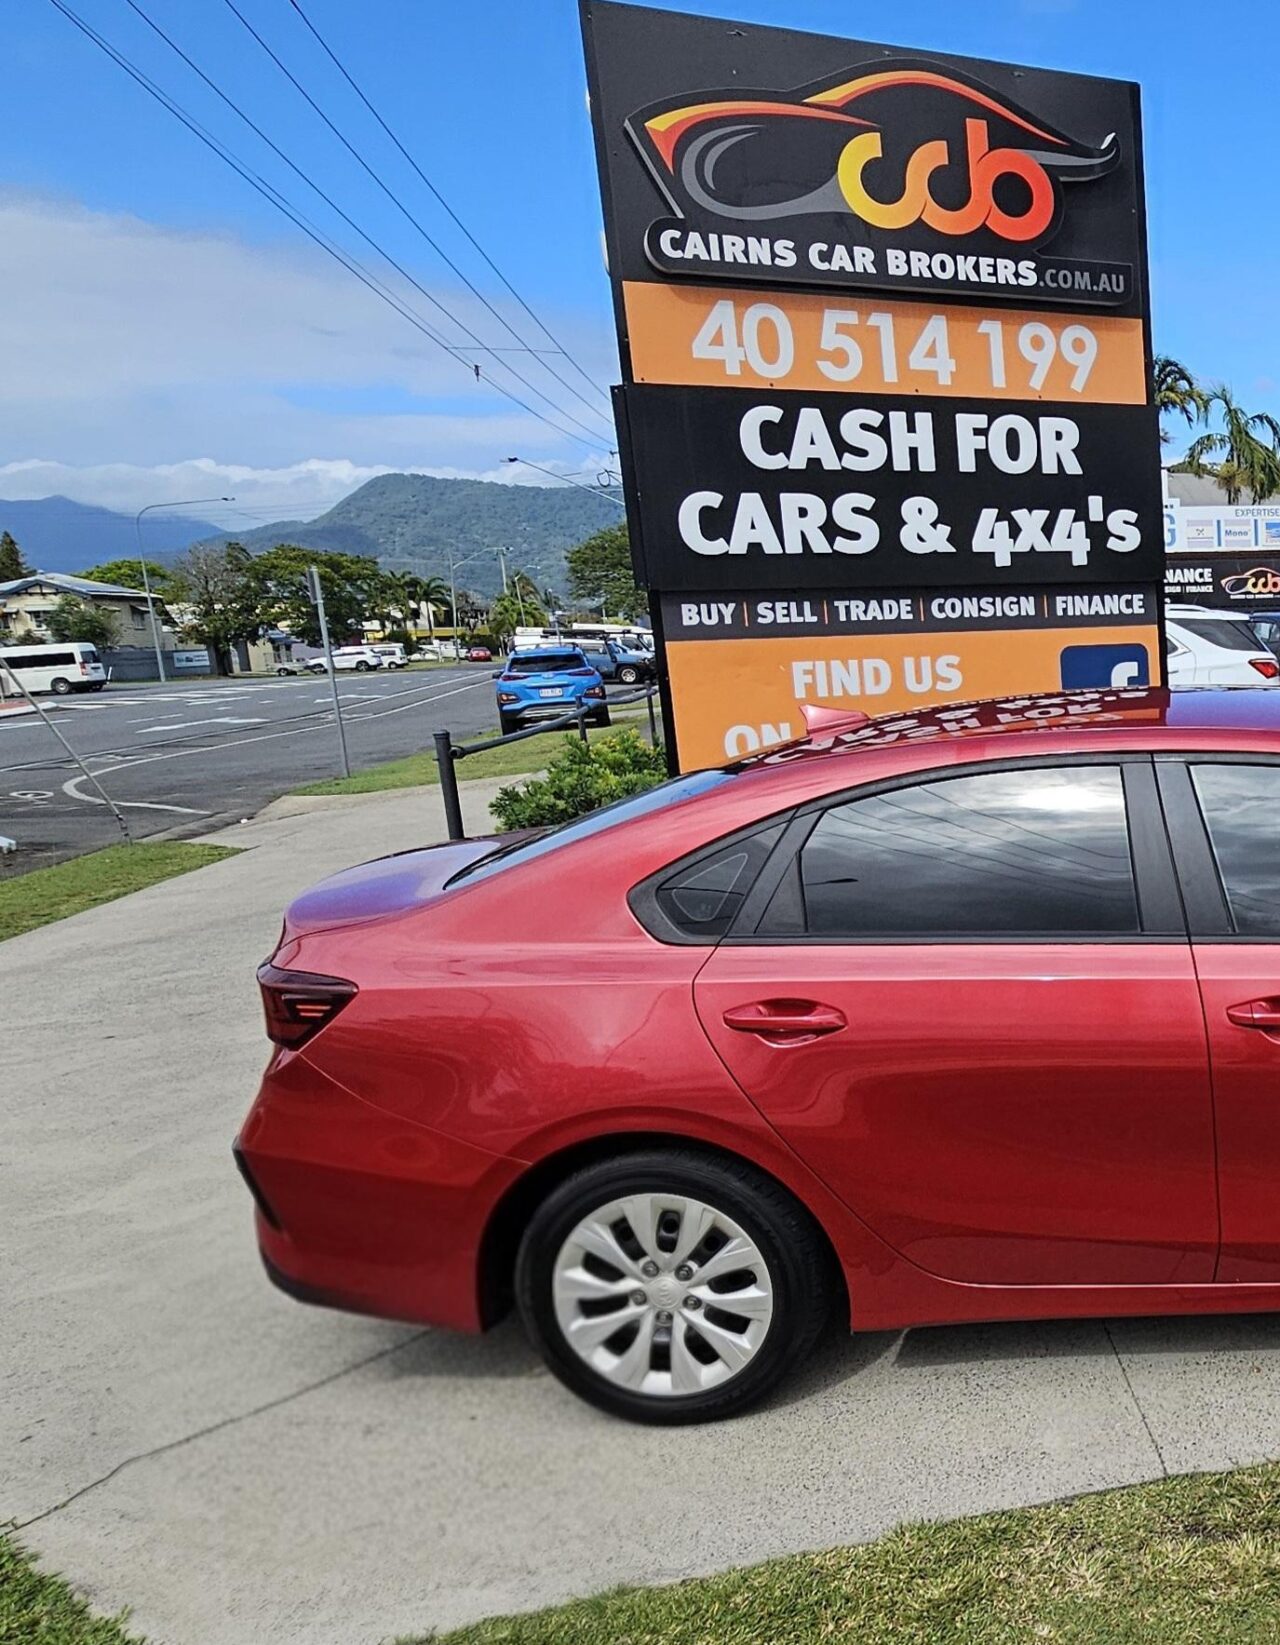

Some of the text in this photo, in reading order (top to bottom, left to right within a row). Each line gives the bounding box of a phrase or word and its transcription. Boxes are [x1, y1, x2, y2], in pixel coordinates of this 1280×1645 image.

[660, 229, 797, 268] CAIRNS
[808, 242, 875, 274] CAR
[691, 300, 1098, 394] 40 514 199
[739, 405, 1083, 476] CASH FOR
[677, 491, 881, 556] CARS
[899, 496, 957, 553] &
[1235, 508, 1280, 517] EXPERTISE
[1163, 568, 1213, 583] NANCE
[681, 594, 1145, 626] BUY SELL TRADE CONSIGN FINANCE
[792, 655, 963, 699] FIND US
[724, 722, 792, 760] ON
